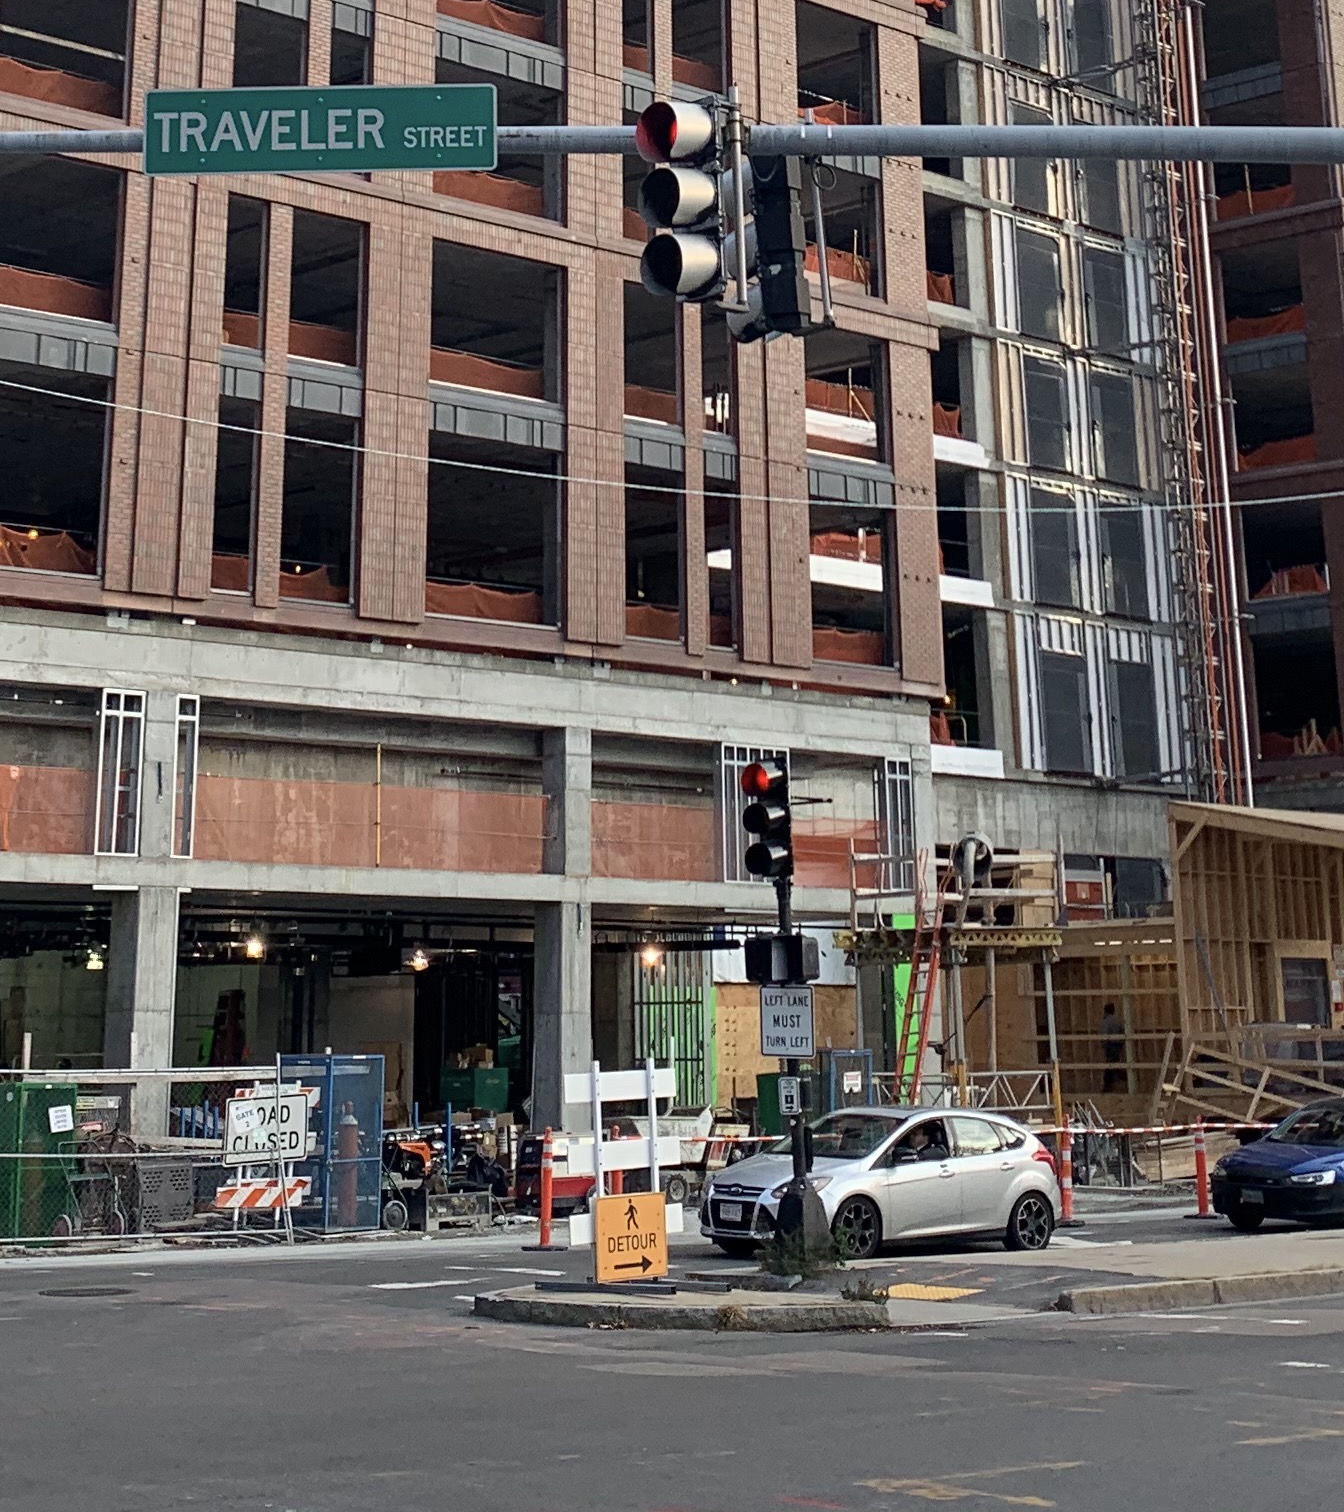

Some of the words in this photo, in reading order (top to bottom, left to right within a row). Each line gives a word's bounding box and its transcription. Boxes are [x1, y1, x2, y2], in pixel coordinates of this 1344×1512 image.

[153, 108, 385, 153] TRAVELER
[403, 125, 487, 149] STREET
[764, 995, 783, 1007] LEFT
[788, 995, 809, 1007] LANE
[772, 1014, 801, 1028] MUST
[766, 1036, 787, 1047] TURN
[790, 1036, 809, 1048] LEFT
[235, 1109, 254, 1121] GATE
[257, 1105, 290, 1126] OAD
[607, 1232, 657, 1254] DETOUR
